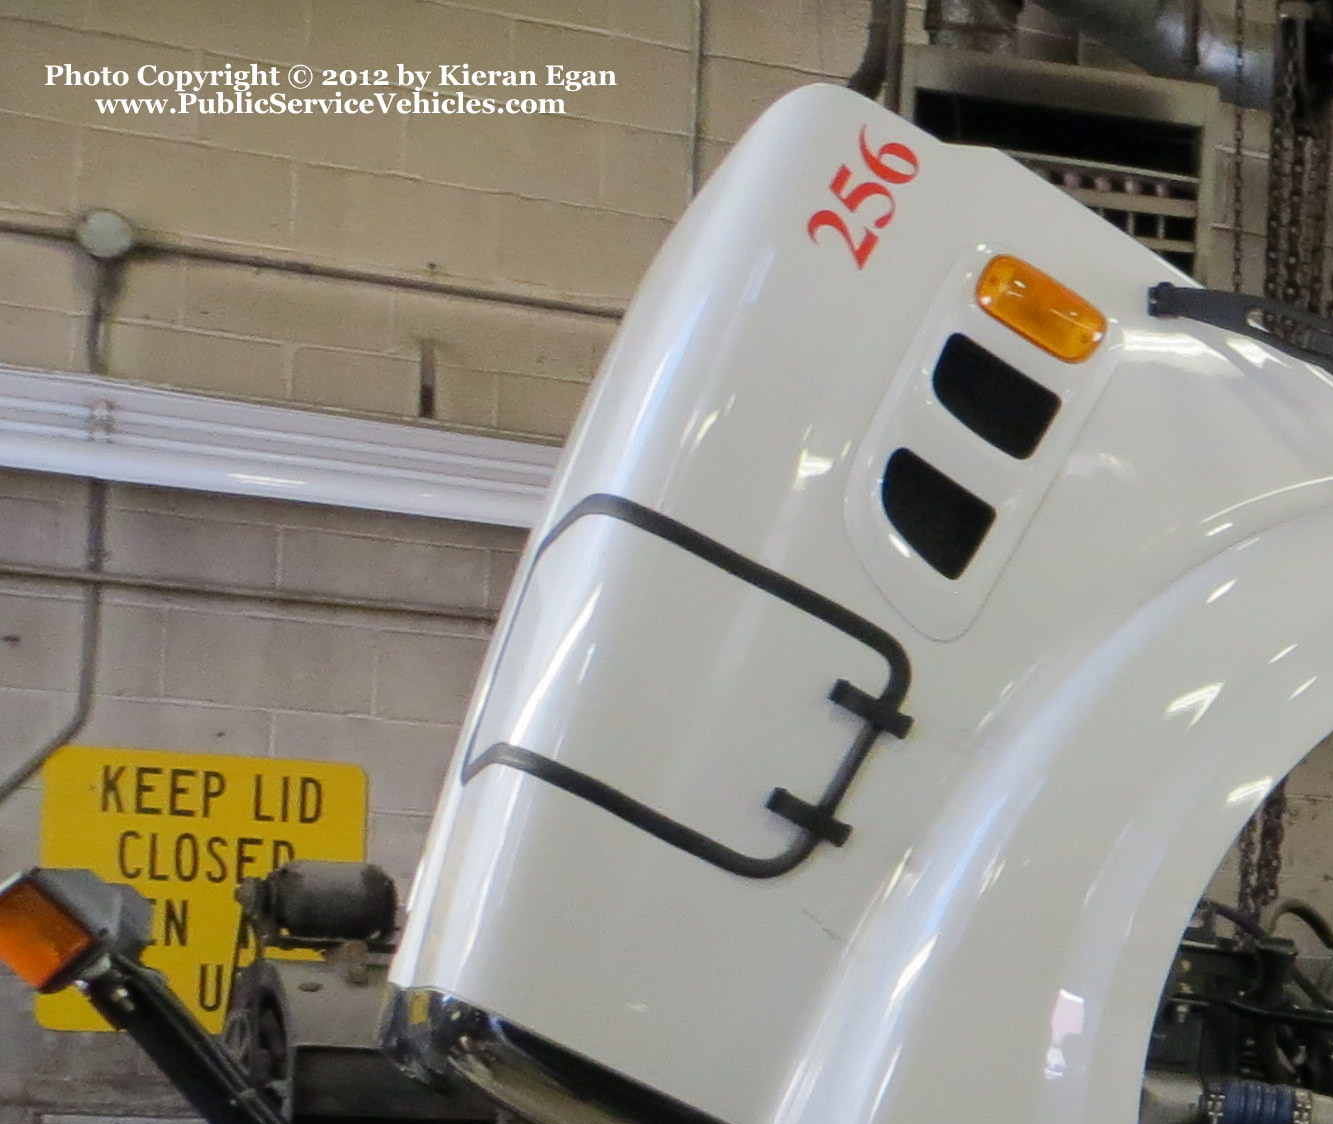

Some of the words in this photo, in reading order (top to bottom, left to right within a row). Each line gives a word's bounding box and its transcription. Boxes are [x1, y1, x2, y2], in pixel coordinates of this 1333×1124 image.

[806, 122, 920, 271] 256
[101, 765, 227, 818] KEEP
[253, 773, 323, 825] LID
